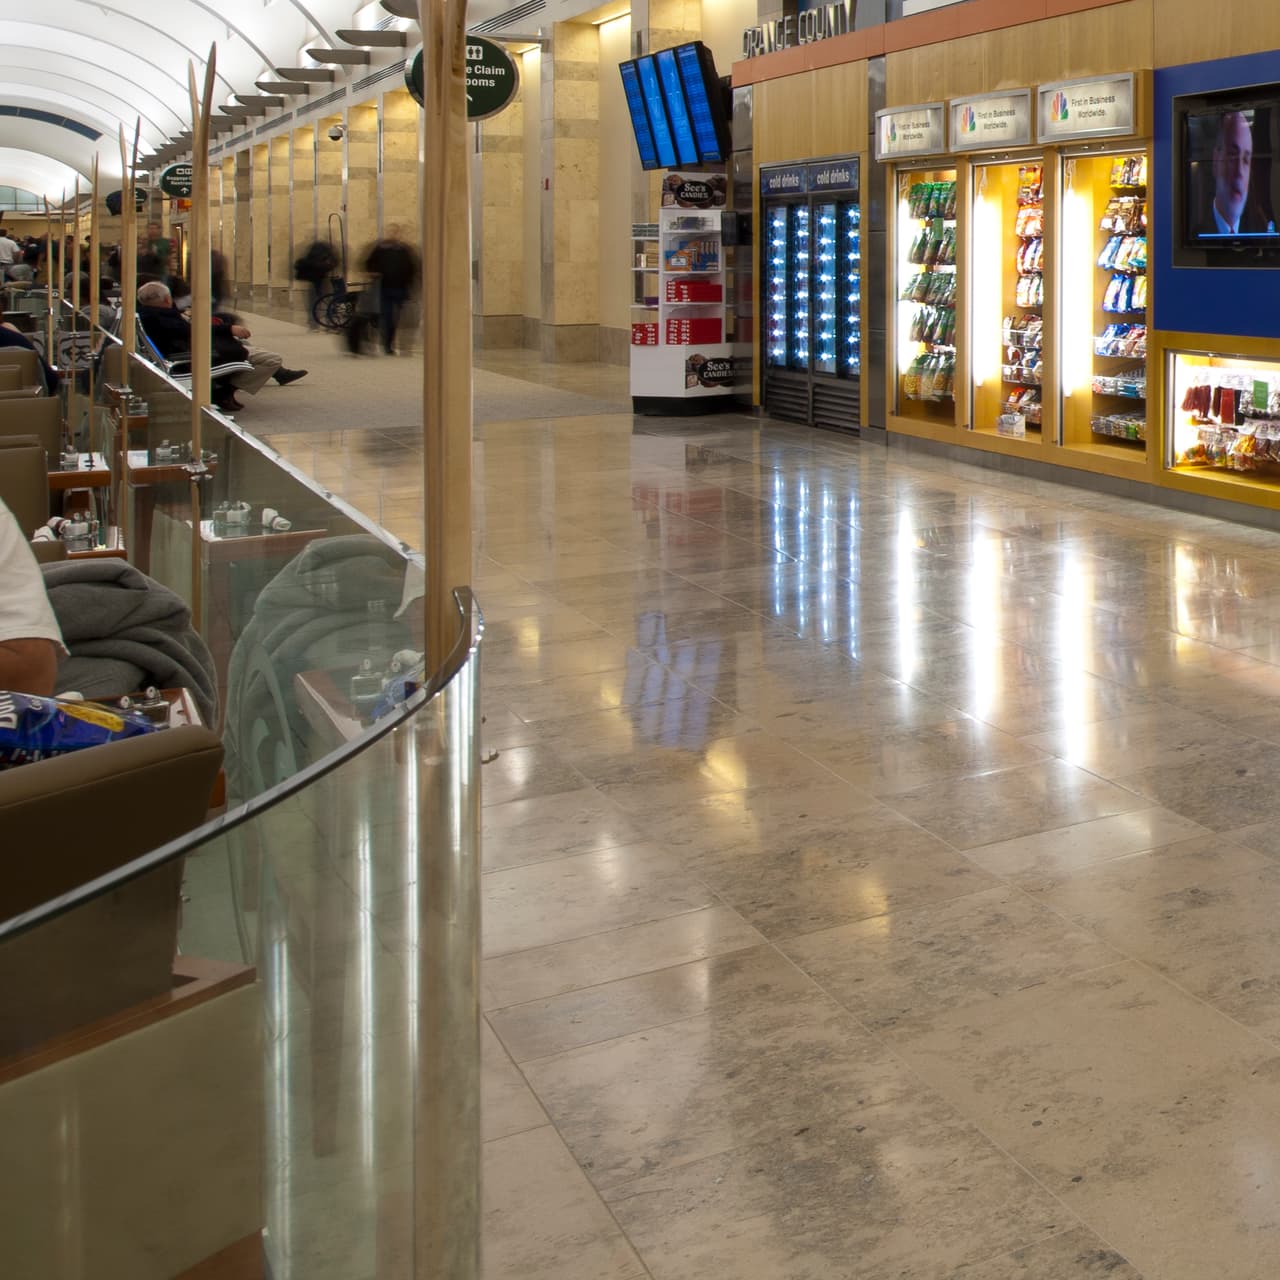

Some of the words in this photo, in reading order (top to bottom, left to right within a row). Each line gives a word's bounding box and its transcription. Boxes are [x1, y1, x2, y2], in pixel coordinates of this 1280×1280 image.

[743, 16, 793, 60] ORANGE
[474, 64, 505, 76] Claim
[769, 175, 781, 188] cold
[782, 174, 799, 187] drinks
[817, 170, 829, 185] cold
[830, 169, 849, 183] drinks
[684, 182, 706, 192] See's
[680, 190, 708, 199] CANDIES
[707, 361, 730, 371] See's
